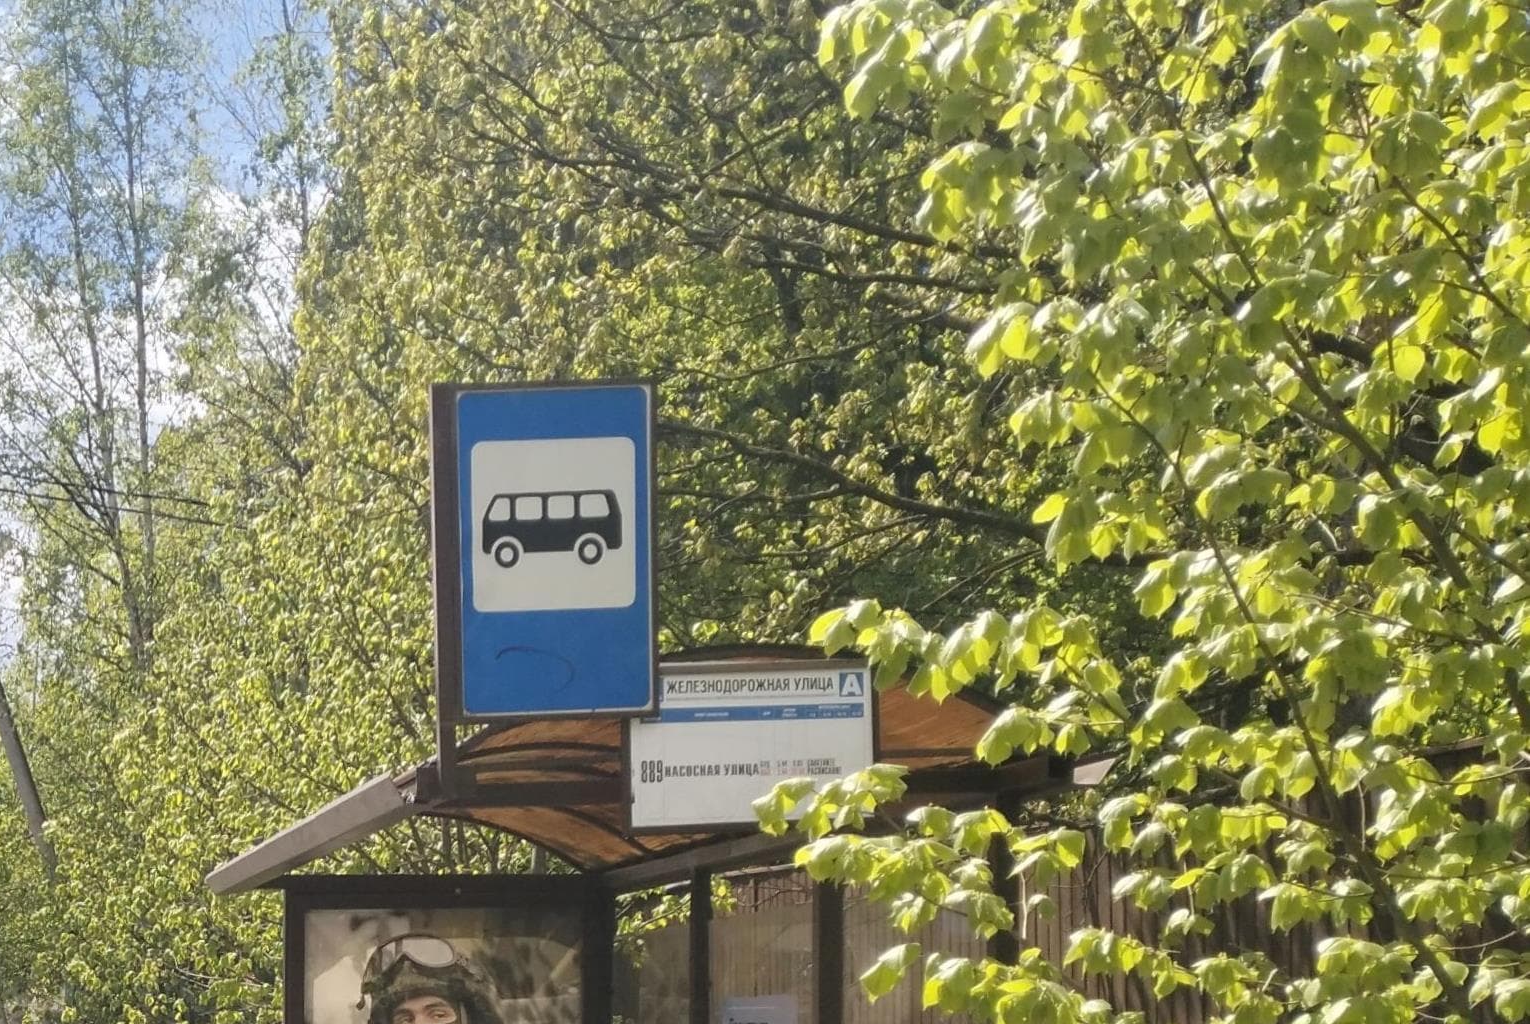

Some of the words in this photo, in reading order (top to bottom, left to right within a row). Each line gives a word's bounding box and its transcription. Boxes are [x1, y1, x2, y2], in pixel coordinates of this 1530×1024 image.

[667, 678, 790, 694] ЖЕЛЕЗНОДОРОЖНАЯ
[794, 676, 833, 692] УЛИЦА
[641, 760, 663, 783] 889
[664, 763, 720, 778] НАСОСНАЯ
[724, 761, 759, 777] УЛИЦА
